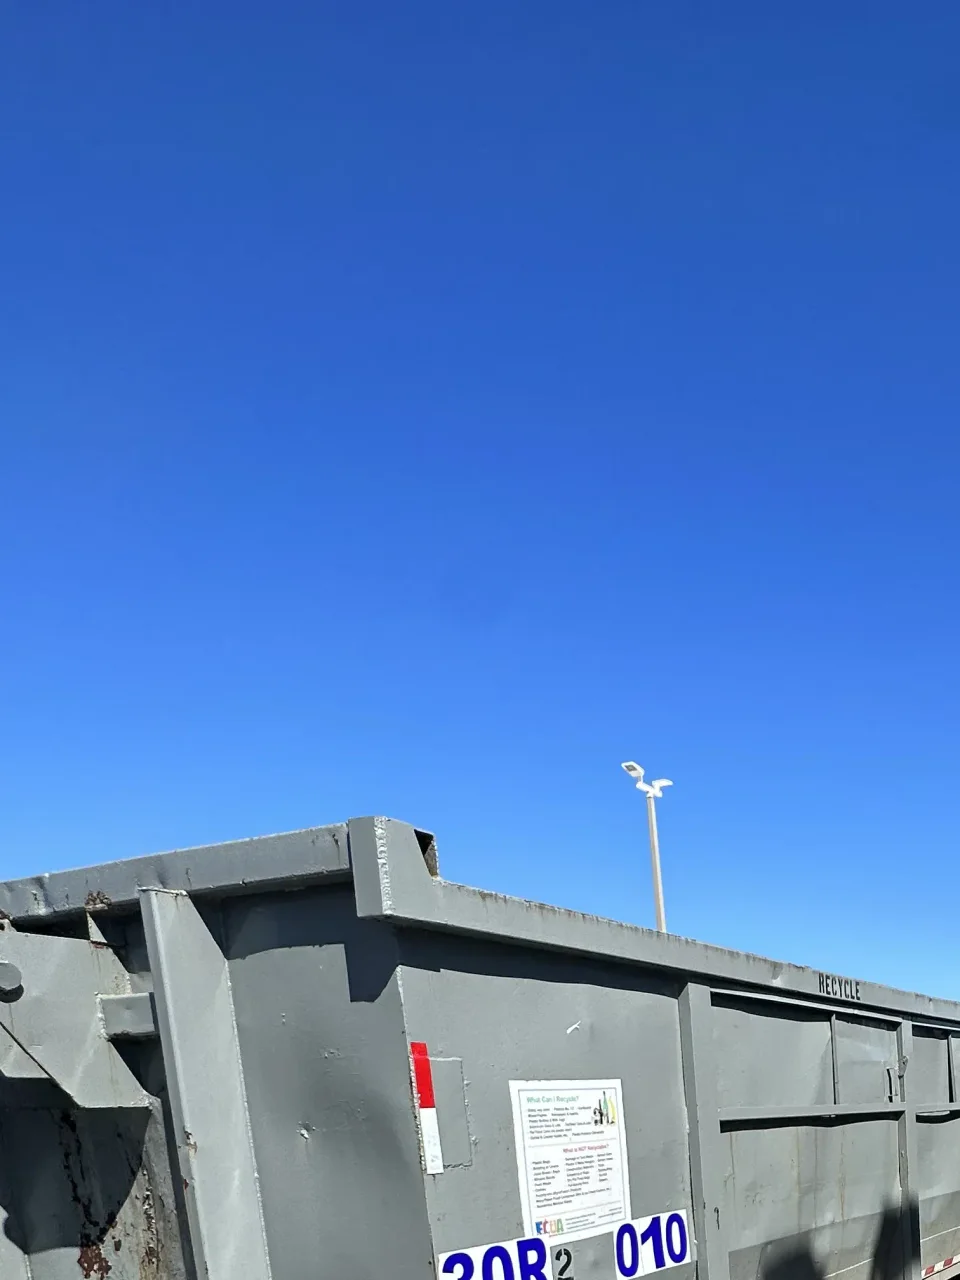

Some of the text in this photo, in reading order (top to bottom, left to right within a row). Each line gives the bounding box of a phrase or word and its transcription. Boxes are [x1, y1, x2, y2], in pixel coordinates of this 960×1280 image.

[818, 972, 861, 1001] RECYCLE
[526, 1095, 540, 1104] What
[541, 1095, 553, 1103] Can
[556, 1094, 579, 1104] Recycle?
[616, 1212, 688, 1278] 010
